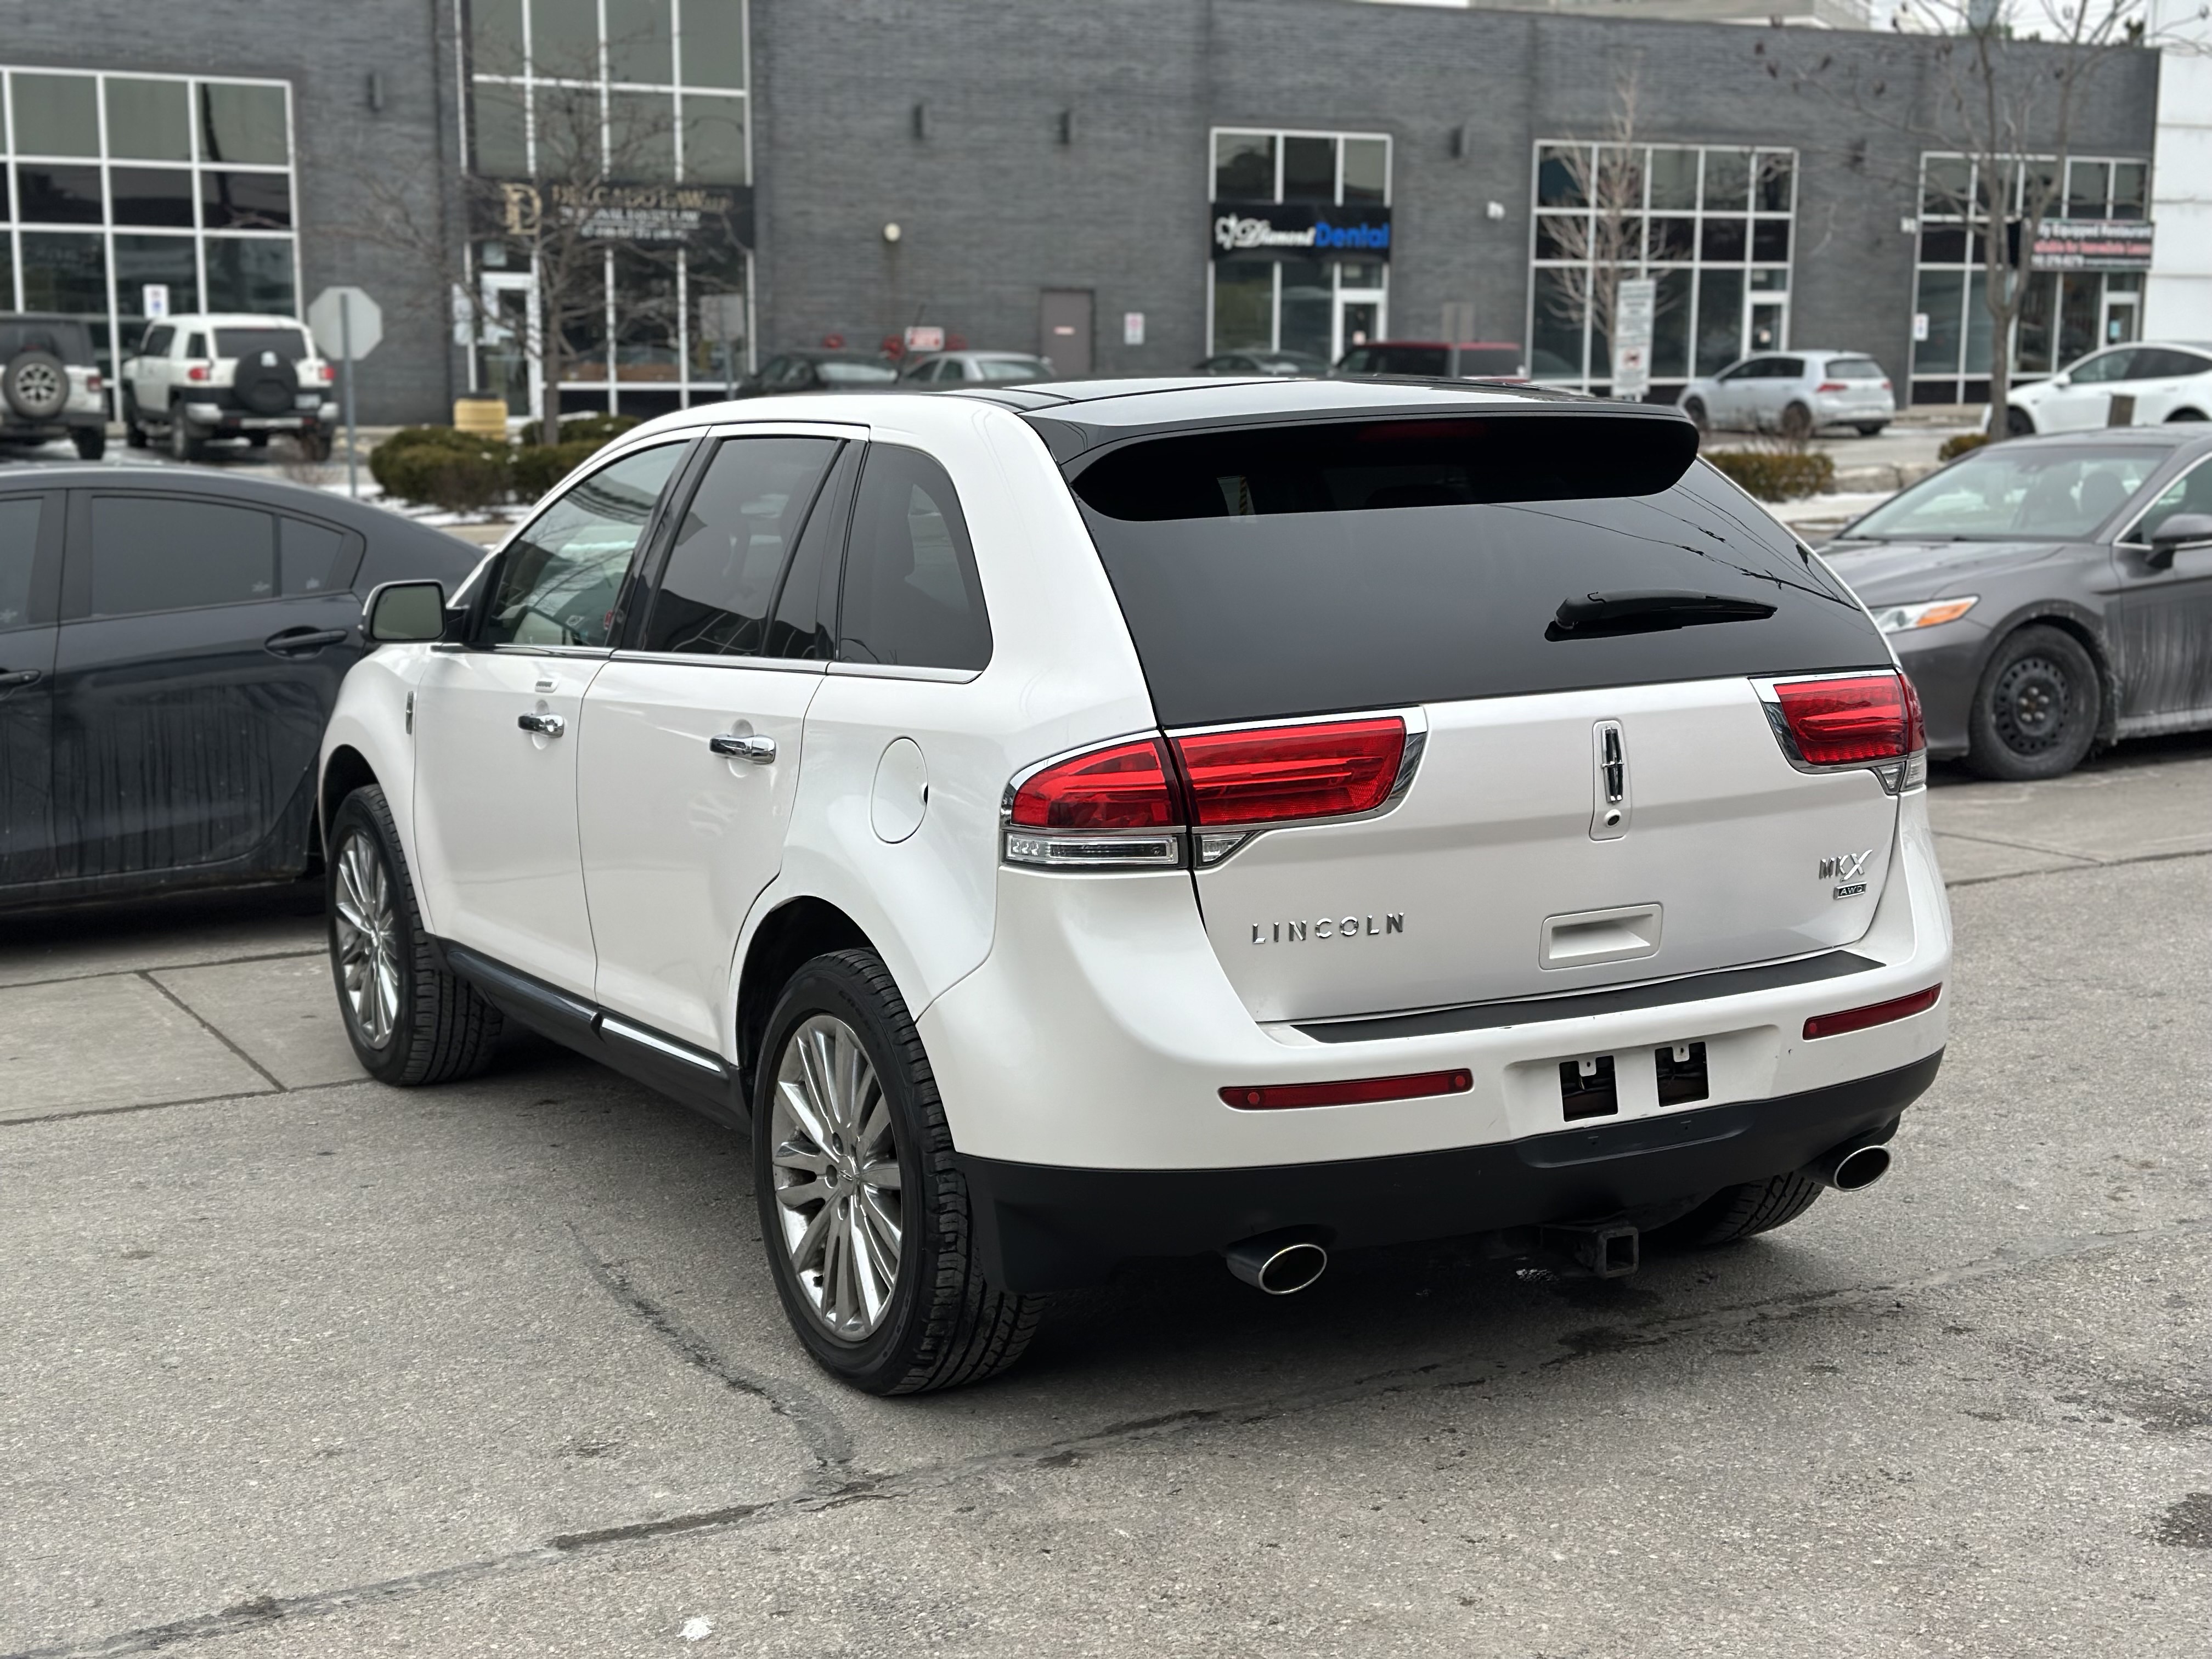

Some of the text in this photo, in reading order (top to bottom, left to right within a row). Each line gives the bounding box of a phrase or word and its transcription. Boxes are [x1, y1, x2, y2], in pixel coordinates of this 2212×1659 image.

[1233, 217, 1390, 248] Diamond Dental
[1819, 849, 1874, 882] MKX
[1840, 885, 1863, 896] AWD
[1251, 912, 1405, 944] LINCOLN
